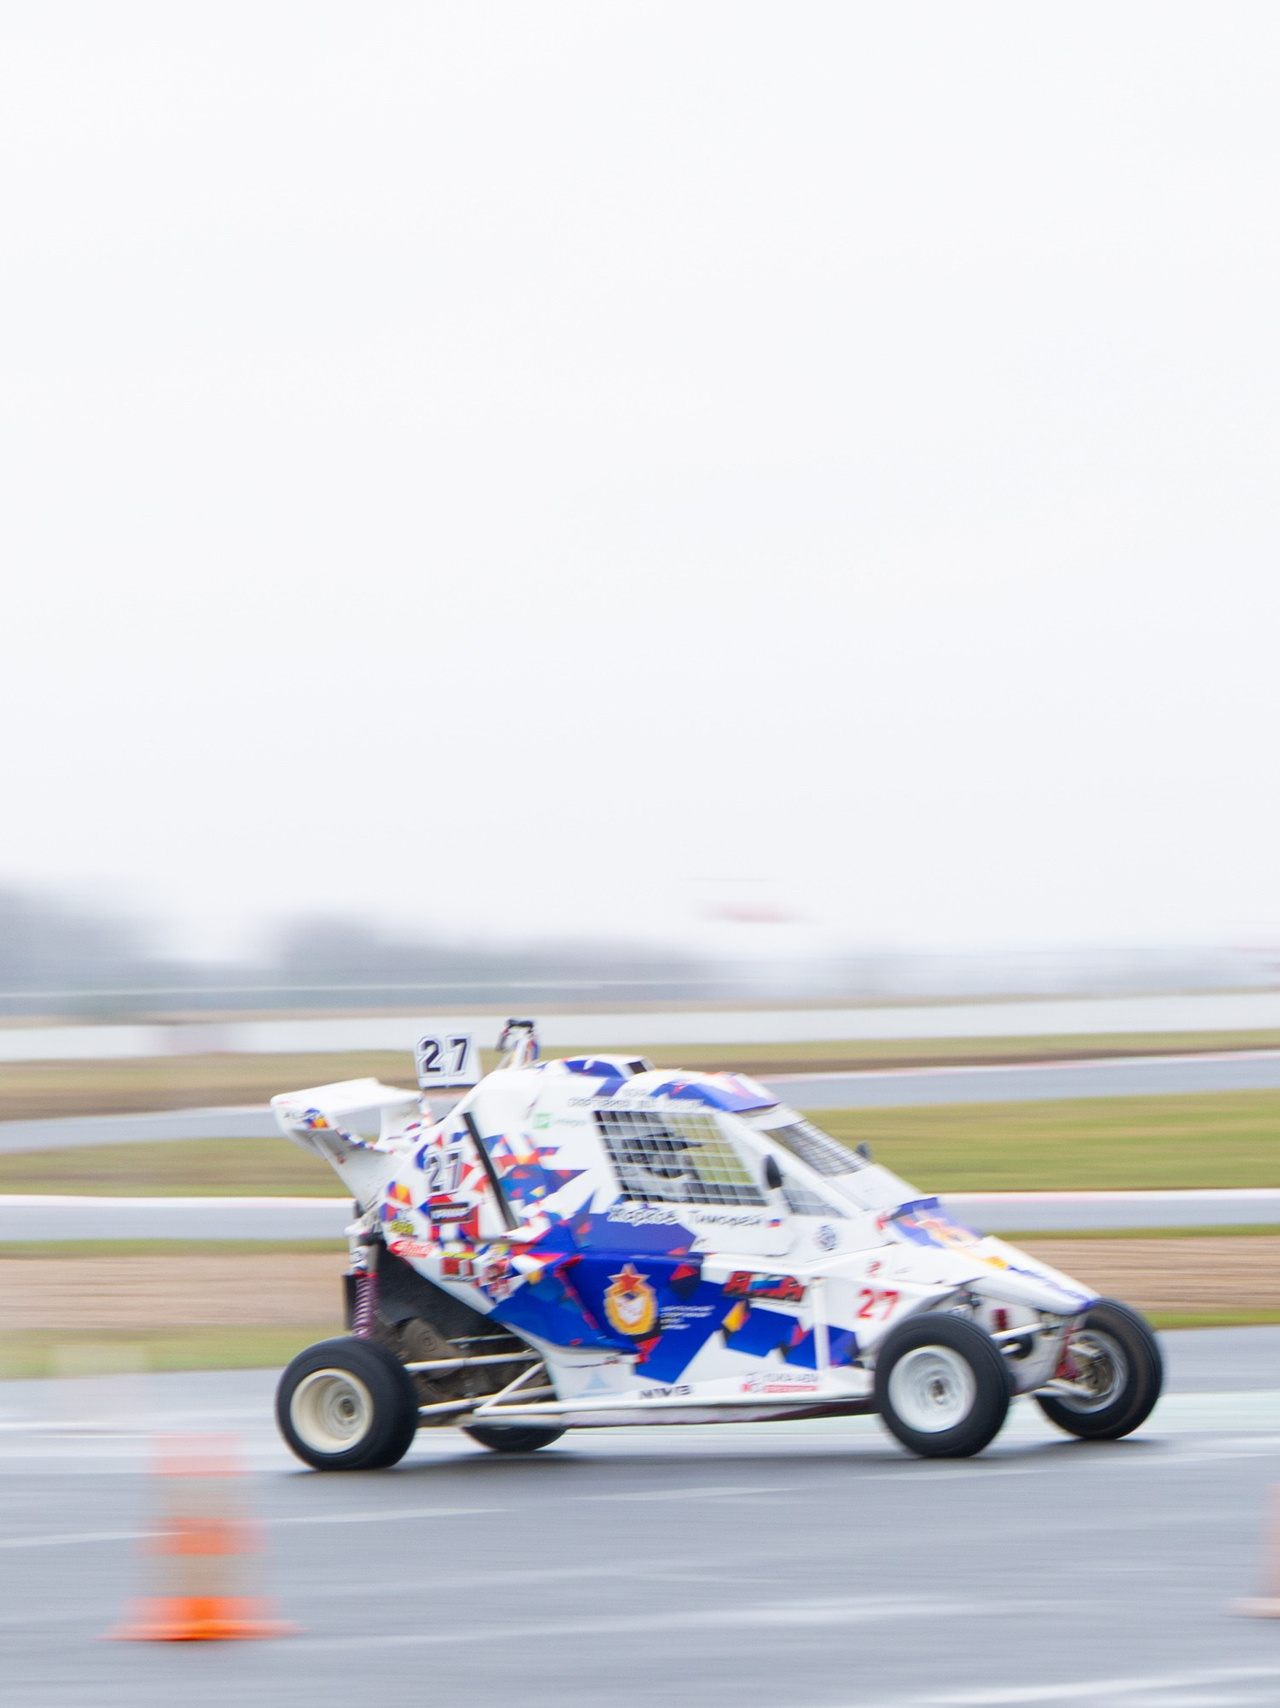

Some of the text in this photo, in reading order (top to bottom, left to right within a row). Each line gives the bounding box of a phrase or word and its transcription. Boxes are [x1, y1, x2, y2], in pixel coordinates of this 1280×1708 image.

[418, 1035, 470, 1076] 27
[424, 1146, 463, 1196] 27
[855, 1288, 900, 1321] 27
